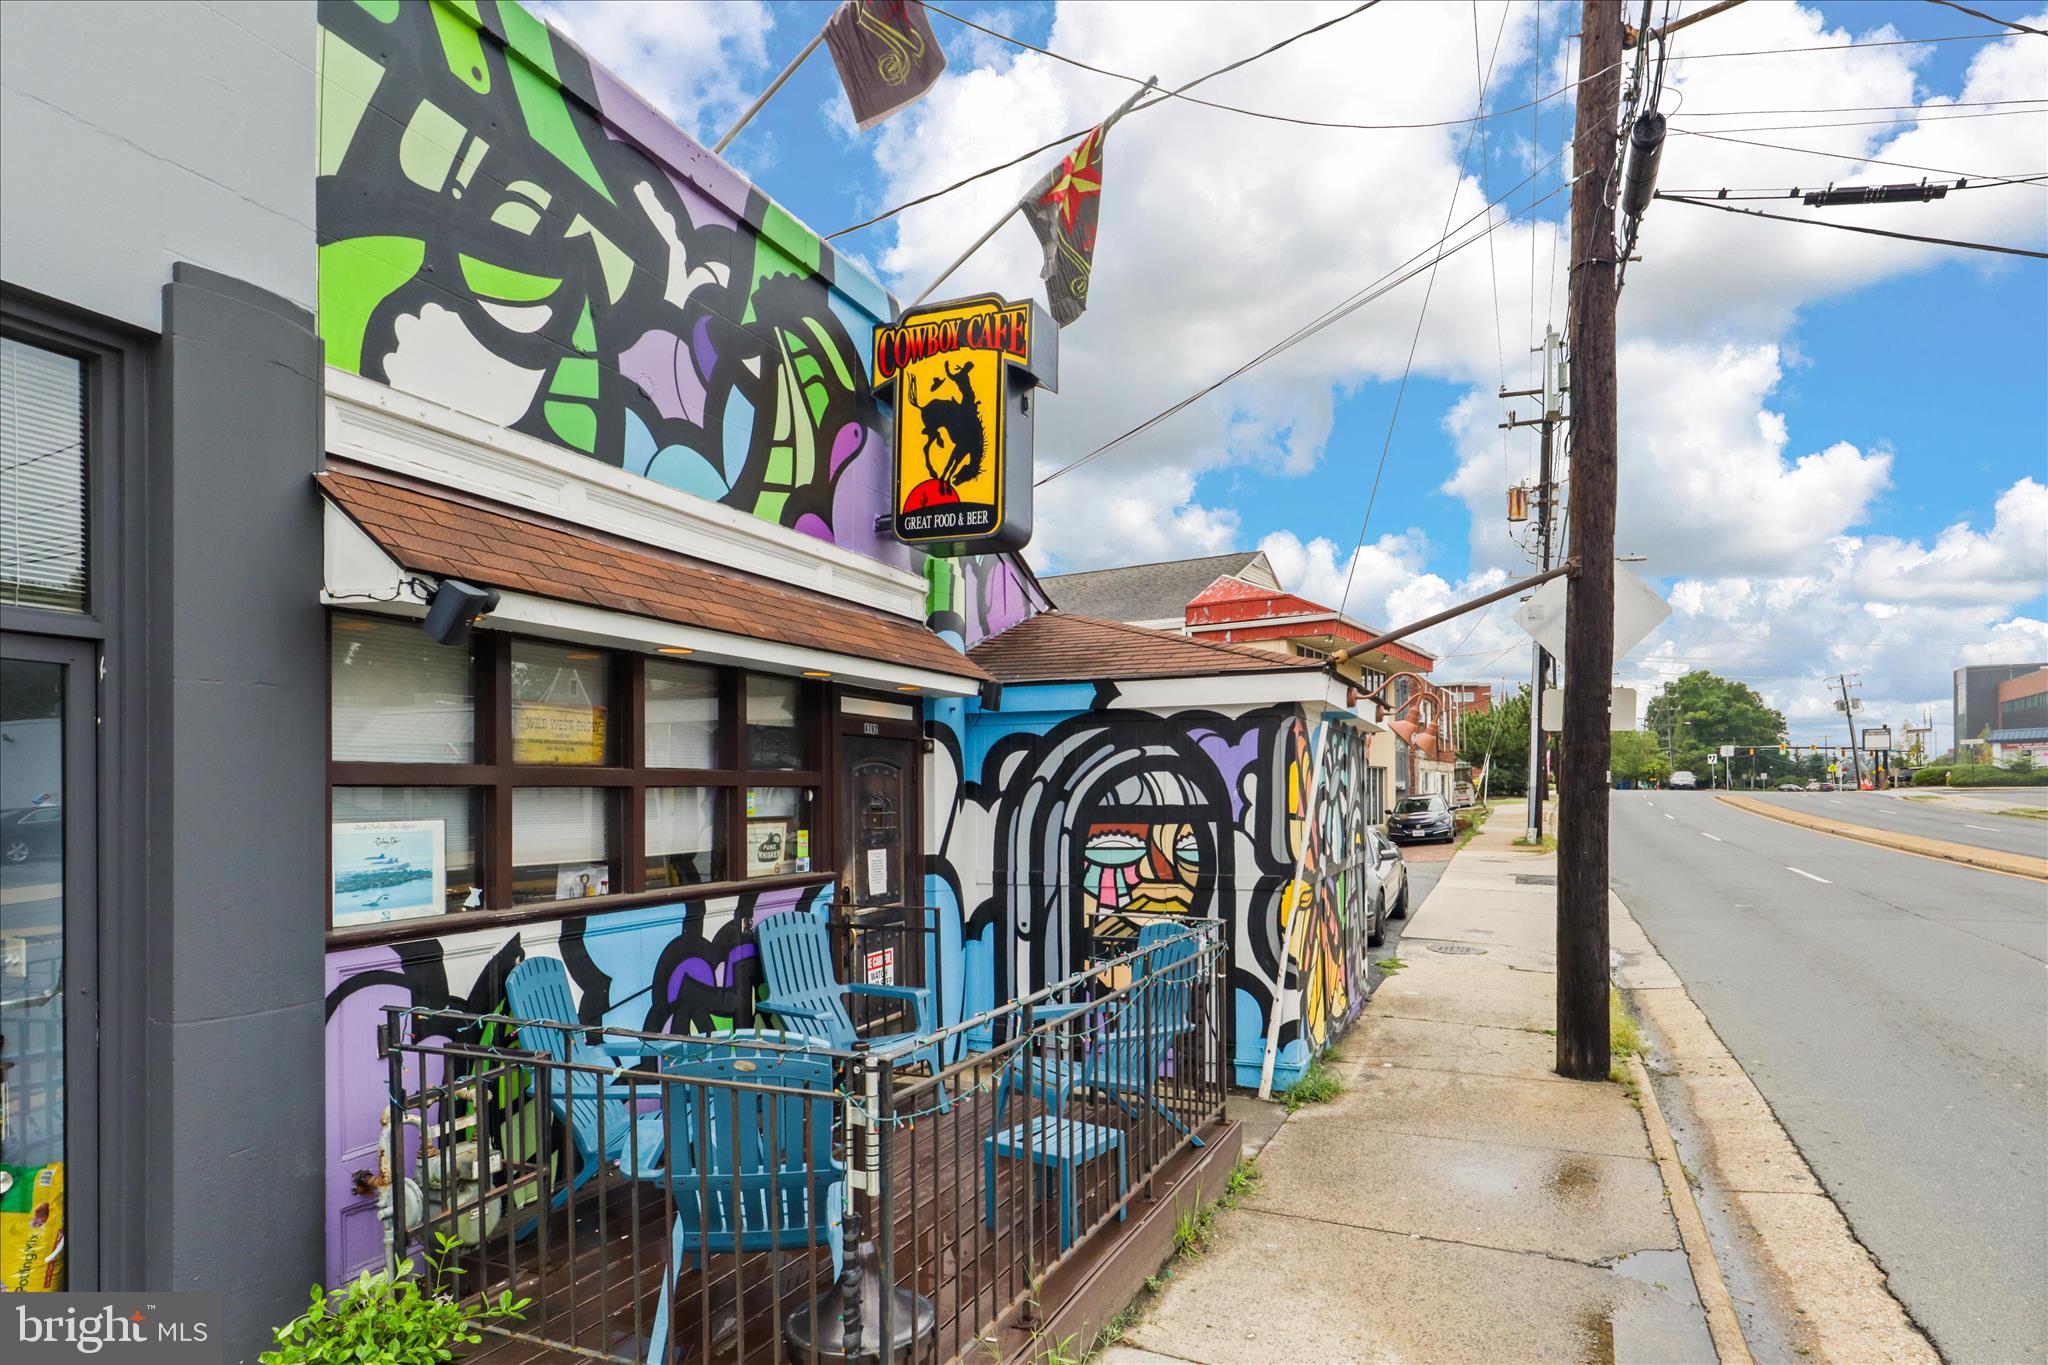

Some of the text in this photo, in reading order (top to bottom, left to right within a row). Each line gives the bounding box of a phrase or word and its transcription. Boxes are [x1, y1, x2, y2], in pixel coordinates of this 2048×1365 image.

[878, 311, 1027, 377] COWBOY CAFE
[904, 510, 989, 530] GREAT FOOD & BEER
[526, 716, 547, 729] WILD
[550, 718, 575, 731] WEST
[24, 1232, 39, 1253] Mix
